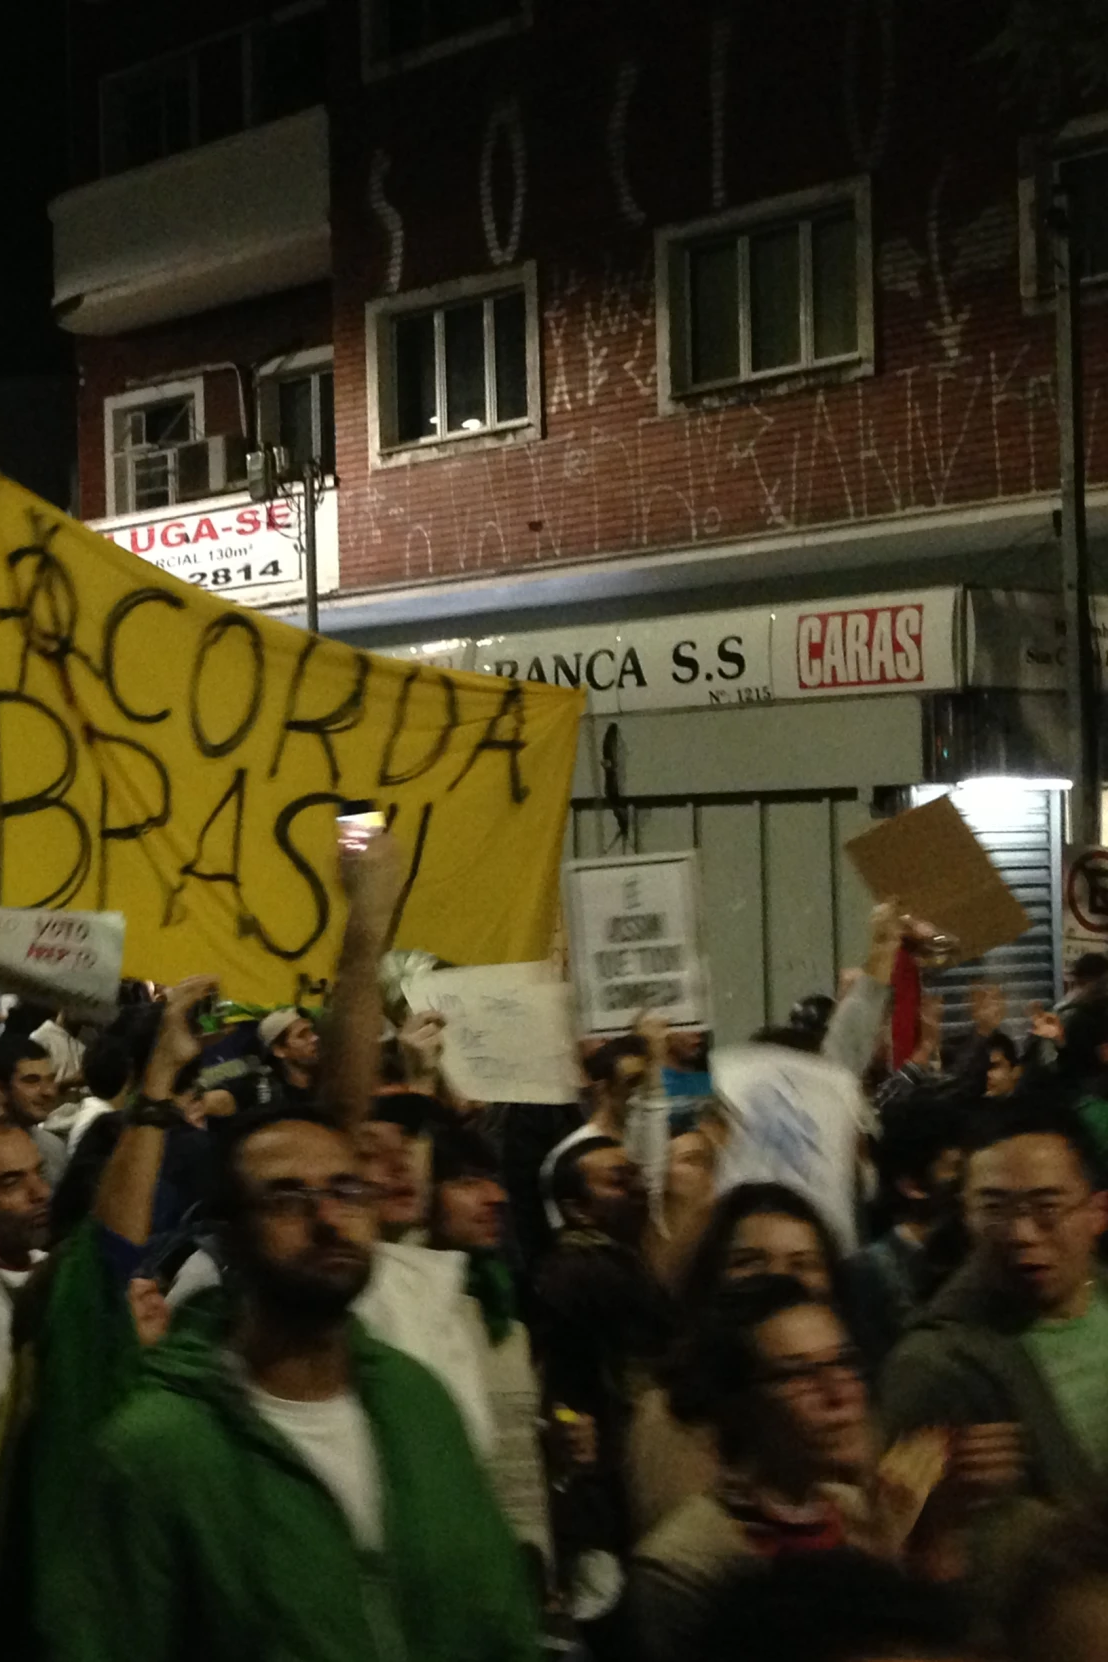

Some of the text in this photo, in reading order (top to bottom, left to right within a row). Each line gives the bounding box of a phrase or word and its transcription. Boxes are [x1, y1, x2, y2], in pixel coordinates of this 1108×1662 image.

[105, 501, 292, 555] UGA-SE
[155, 553, 200, 569] RCIAL
[188, 560, 283, 588] 2814
[671, 635, 746, 683] S.S
[798, 607, 923, 687] CARAS
